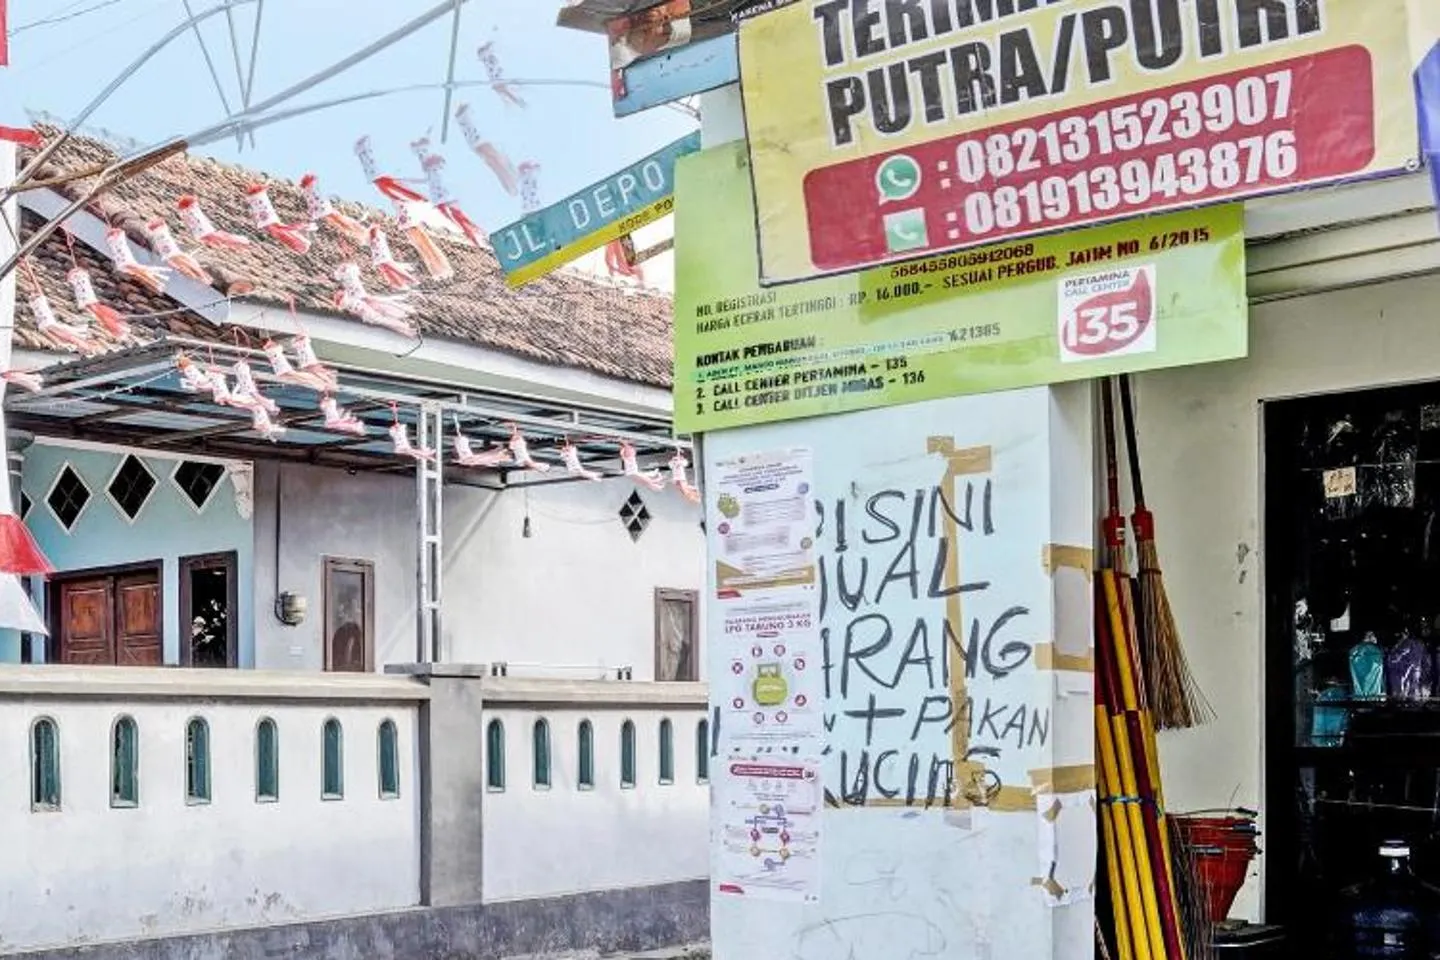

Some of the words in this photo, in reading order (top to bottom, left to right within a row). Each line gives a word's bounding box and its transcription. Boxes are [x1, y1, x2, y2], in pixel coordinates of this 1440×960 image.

[654, 196, 674, 212] PO
[696, 316, 731, 334] HARGA
[733, 307, 775, 327] ECERAN
[779, 296, 836, 319] TERTINGGI
[942, 271, 993, 289] SESUAI
[1065, 245, 1112, 267] JATIM
[1149, 228, 1209, 250] 6/2015
[1064, 269, 1130, 288] PERTAMINA
[1064, 286, 1088, 297] CALL
[1091, 279, 1130, 293] CENTER
[716, 292, 777, 313] REGISTRASI
[1066, 302, 1139, 347] 135
[696, 348, 740, 368] KONTAK
[713, 382, 741, 396] CALL
[744, 374, 790, 391] CENTER
[794, 363, 866, 383] PERTAMINA
[886, 356, 907, 371] 135
[713, 397, 740, 412] CALL
[744, 389, 790, 408] CENTER
[903, 370, 925, 385] 136
[911, 696, 1050, 749] PAKAN
